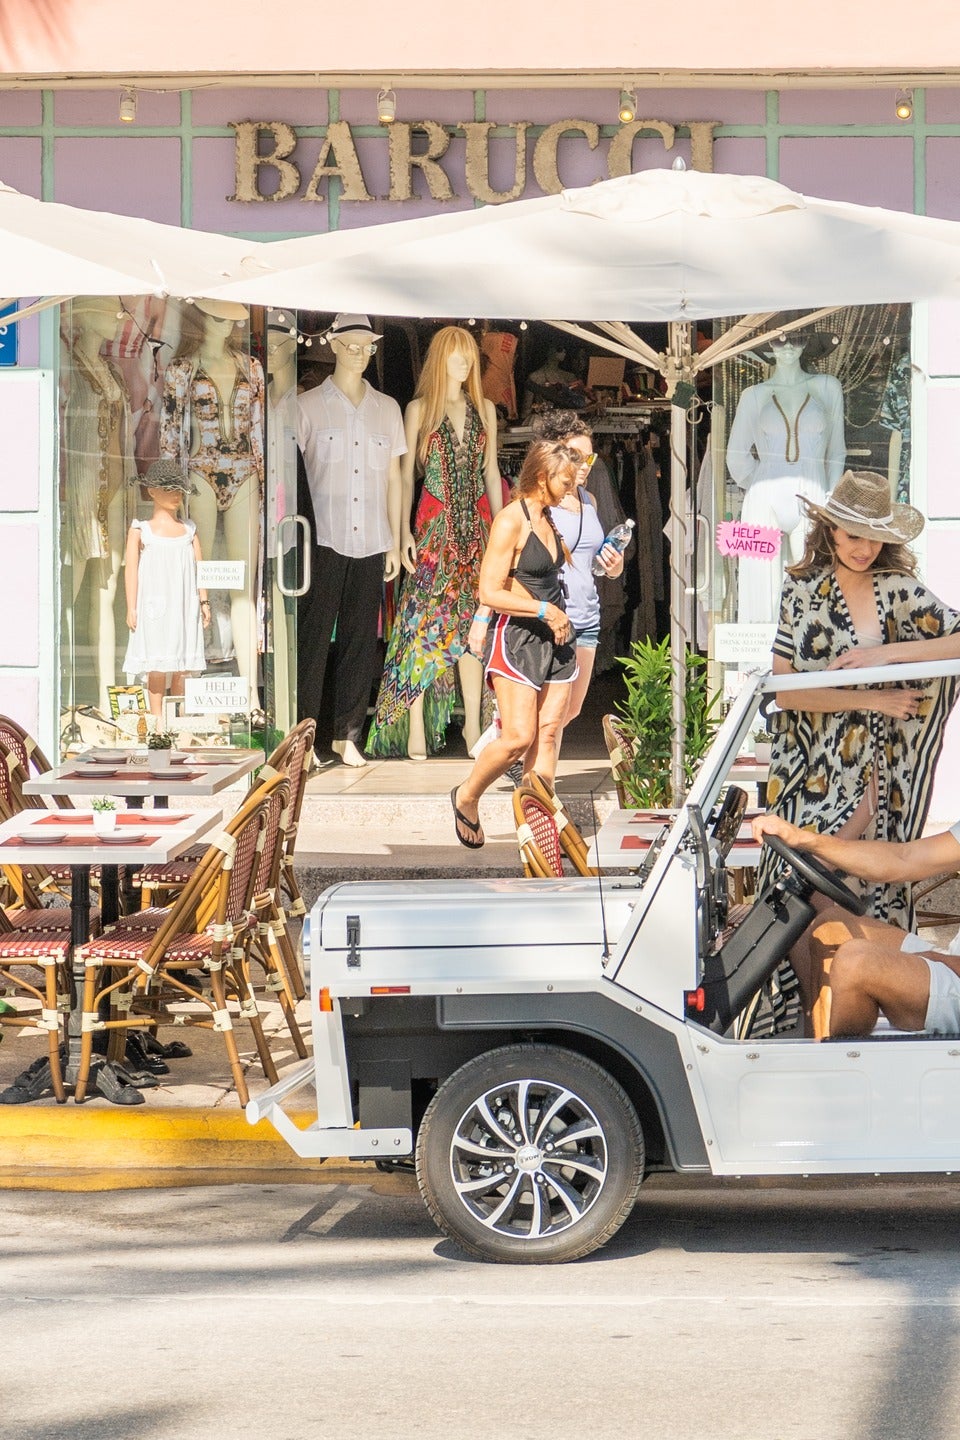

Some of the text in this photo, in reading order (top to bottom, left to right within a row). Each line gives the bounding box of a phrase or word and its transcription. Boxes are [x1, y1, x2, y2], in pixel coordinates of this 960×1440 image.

[226, 118, 724, 205] BARUCCI
[732, 527, 761, 539] HELP
[725, 539, 776, 554] WANTED
[205, 681, 236, 691] HELP
[194, 696, 248, 706] WANTED
